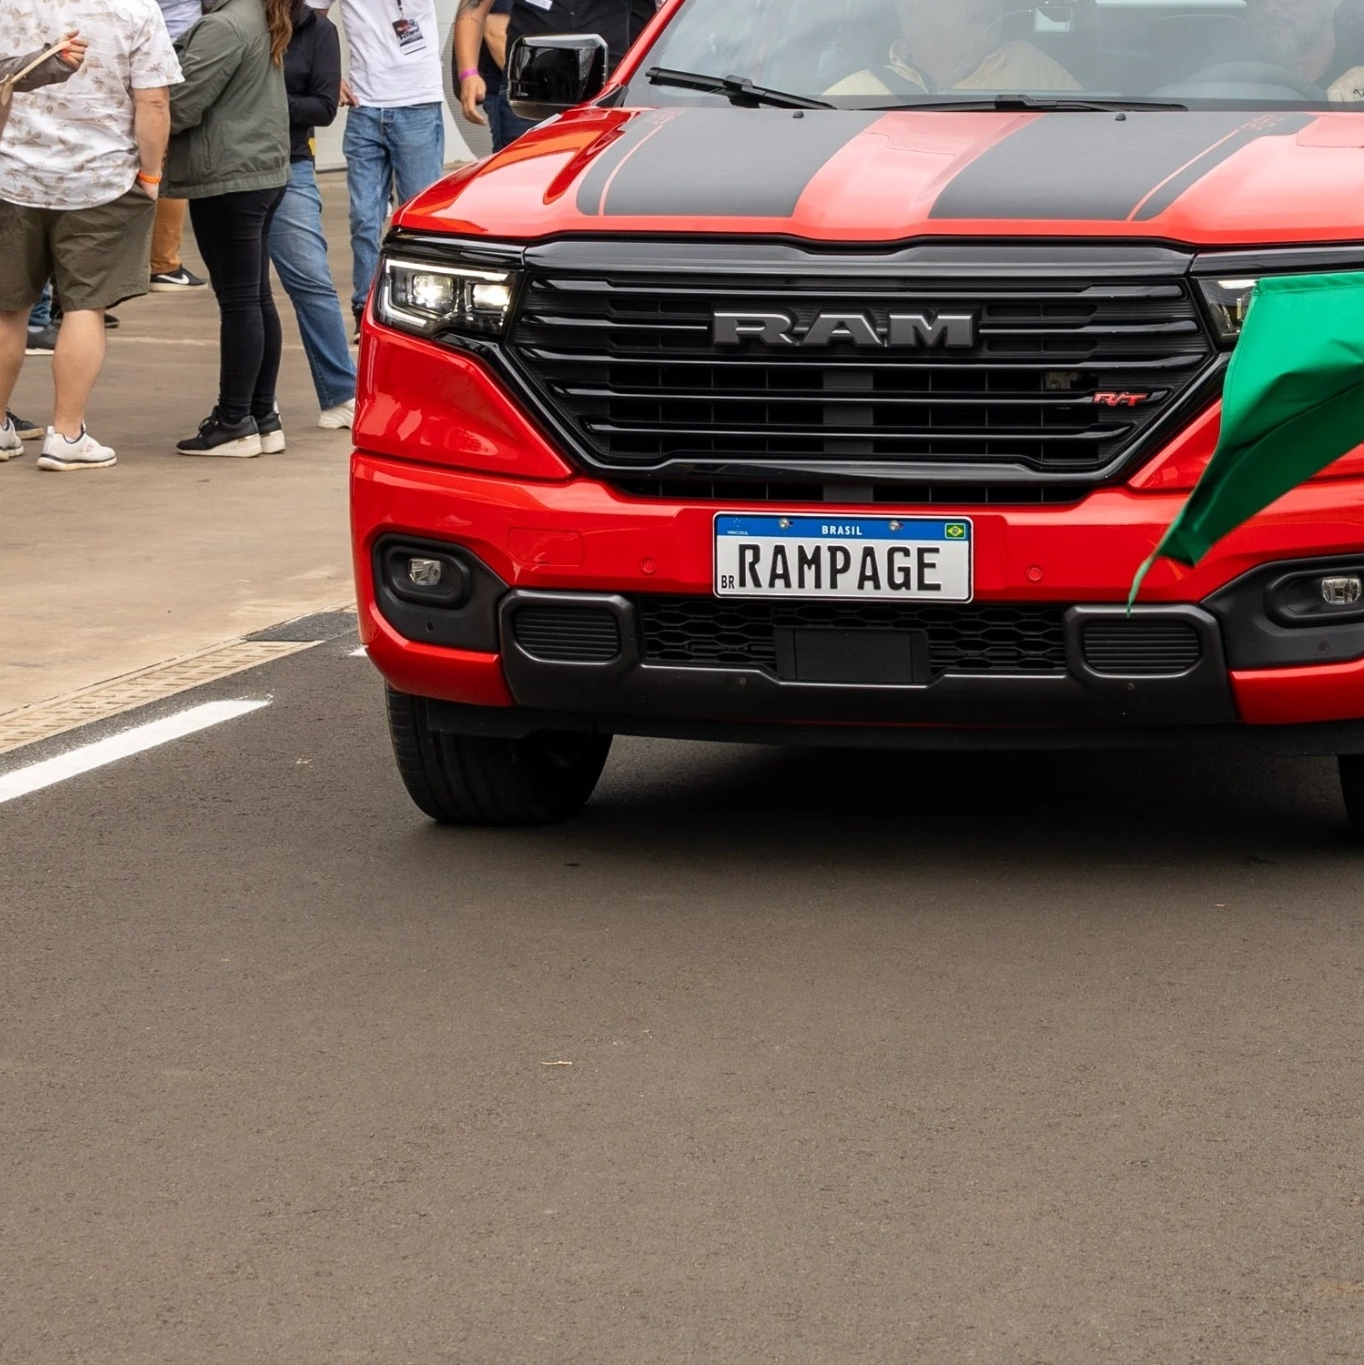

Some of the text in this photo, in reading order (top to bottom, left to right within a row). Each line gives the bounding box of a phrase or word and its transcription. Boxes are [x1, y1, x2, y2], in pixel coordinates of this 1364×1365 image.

[712, 309, 975, 348] RAM
[1093, 391, 1148, 406] R/T
[821, 525, 863, 536] BRASIL
[738, 543, 942, 591] RAMPAGE
[721, 574, 735, 589] BR
